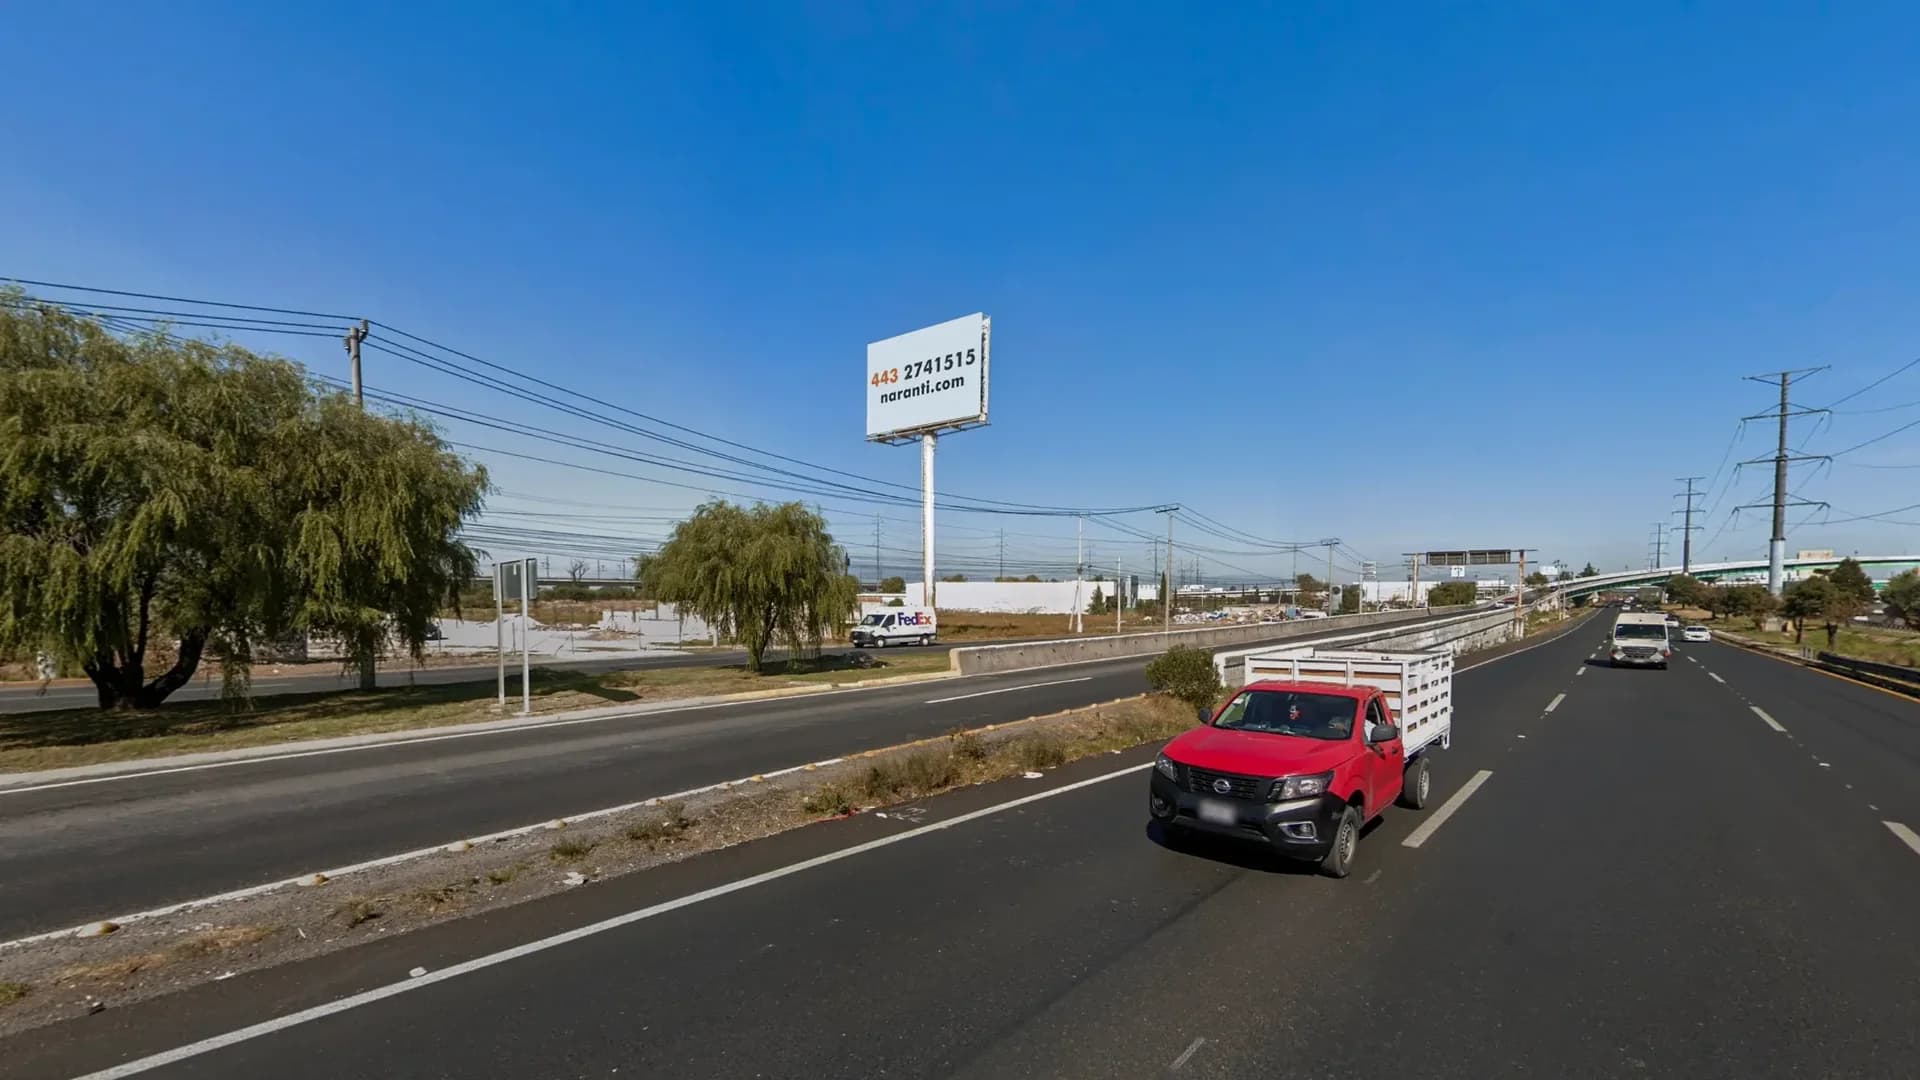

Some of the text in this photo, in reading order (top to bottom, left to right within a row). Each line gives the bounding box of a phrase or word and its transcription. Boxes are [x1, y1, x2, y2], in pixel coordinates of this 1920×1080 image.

[871, 348, 976, 387] 443 2741515
[880, 376, 965, 404] naranti.com
[897, 611, 932, 626] FedEx
